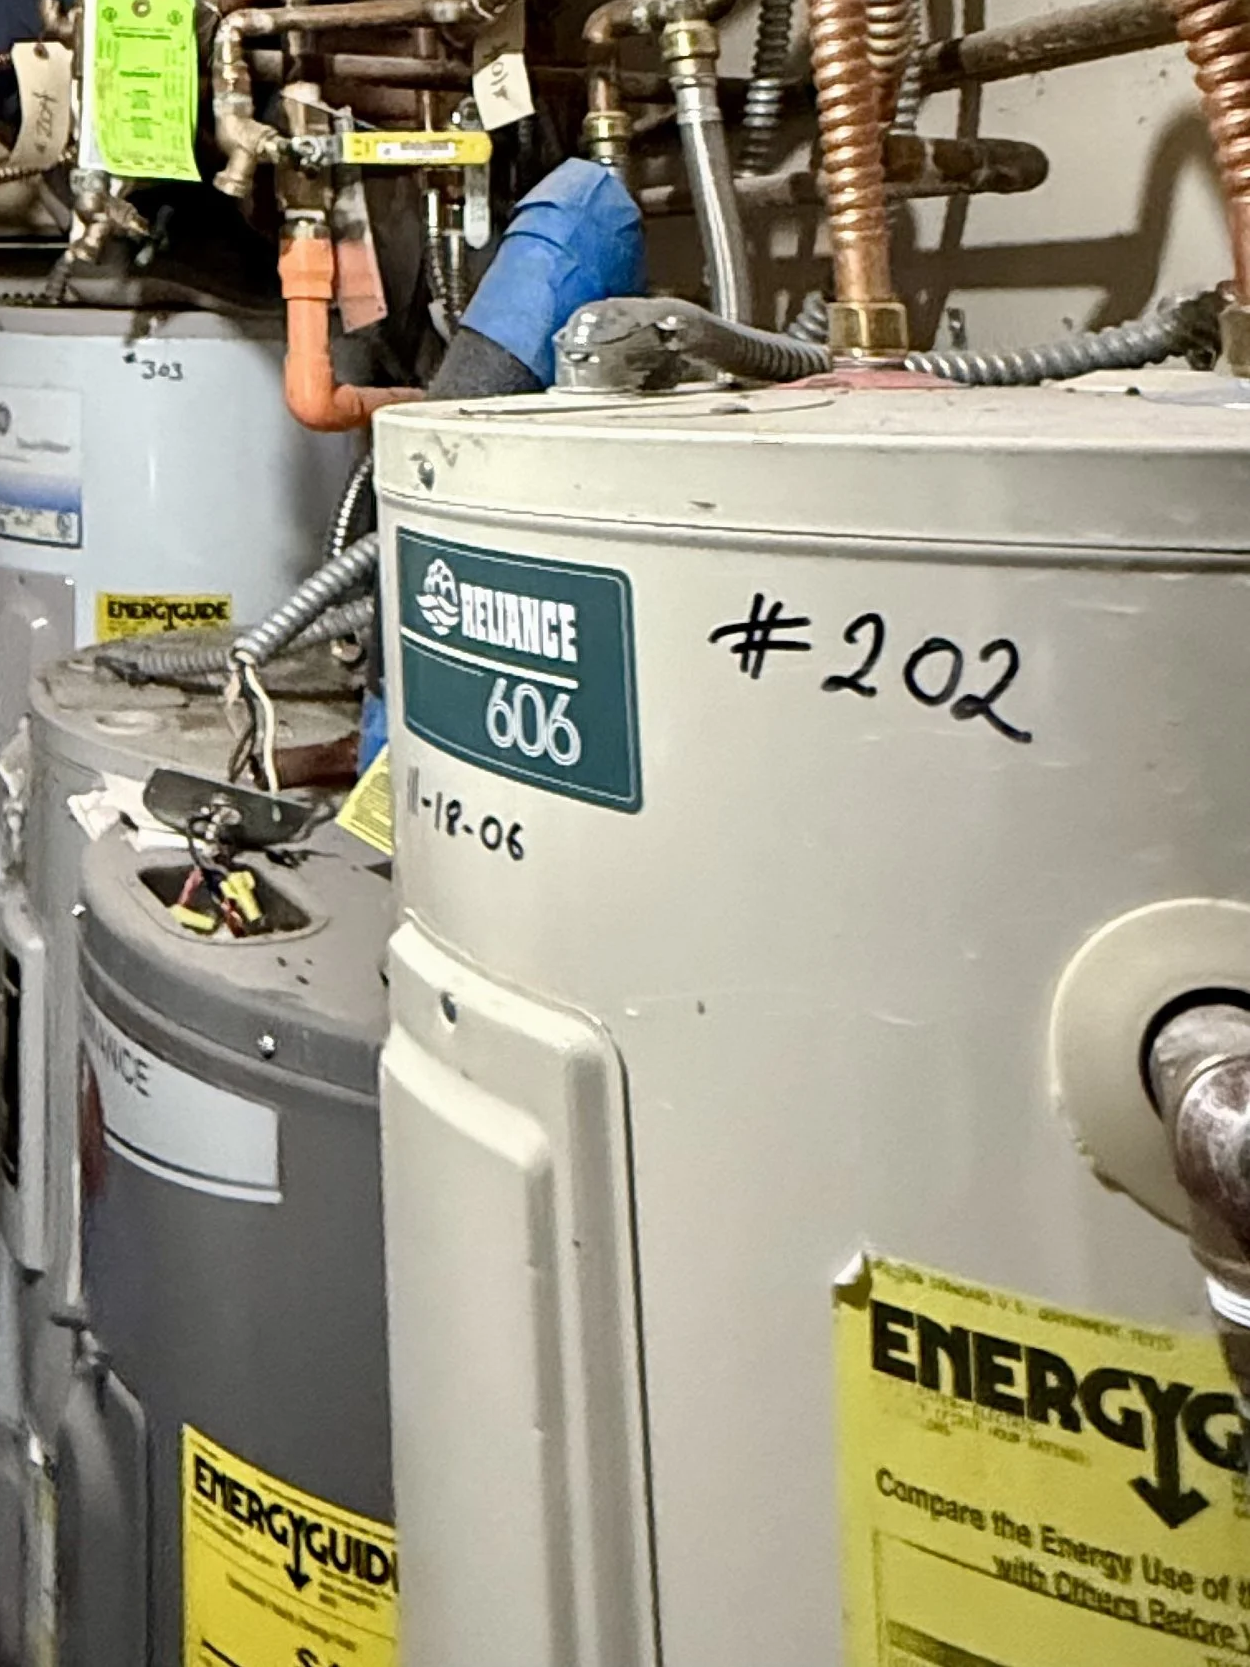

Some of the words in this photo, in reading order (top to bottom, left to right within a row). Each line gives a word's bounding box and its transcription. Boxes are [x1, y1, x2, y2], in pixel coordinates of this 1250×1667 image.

[460, 582, 578, 662] RELIANCE
[707, 592, 1033, 744] #202
[486, 677, 582, 766] 606
[870, 1298, 1250, 1530] ENERGYG
[194, 1452, 400, 1594] ENERGYGUID
[875, 1468, 986, 1531] Compare
[992, 1509, 1032, 1547] the
[1040, 1524, 1134, 1584] Energy
[1141, 1553, 1194, 1594] Use
[1202, 1574, 1230, 1603] of
[993, 1554, 1046, 1592] with
[1053, 1571, 1140, 1624] Others
[1148, 1599, 1236, 1649] Before
